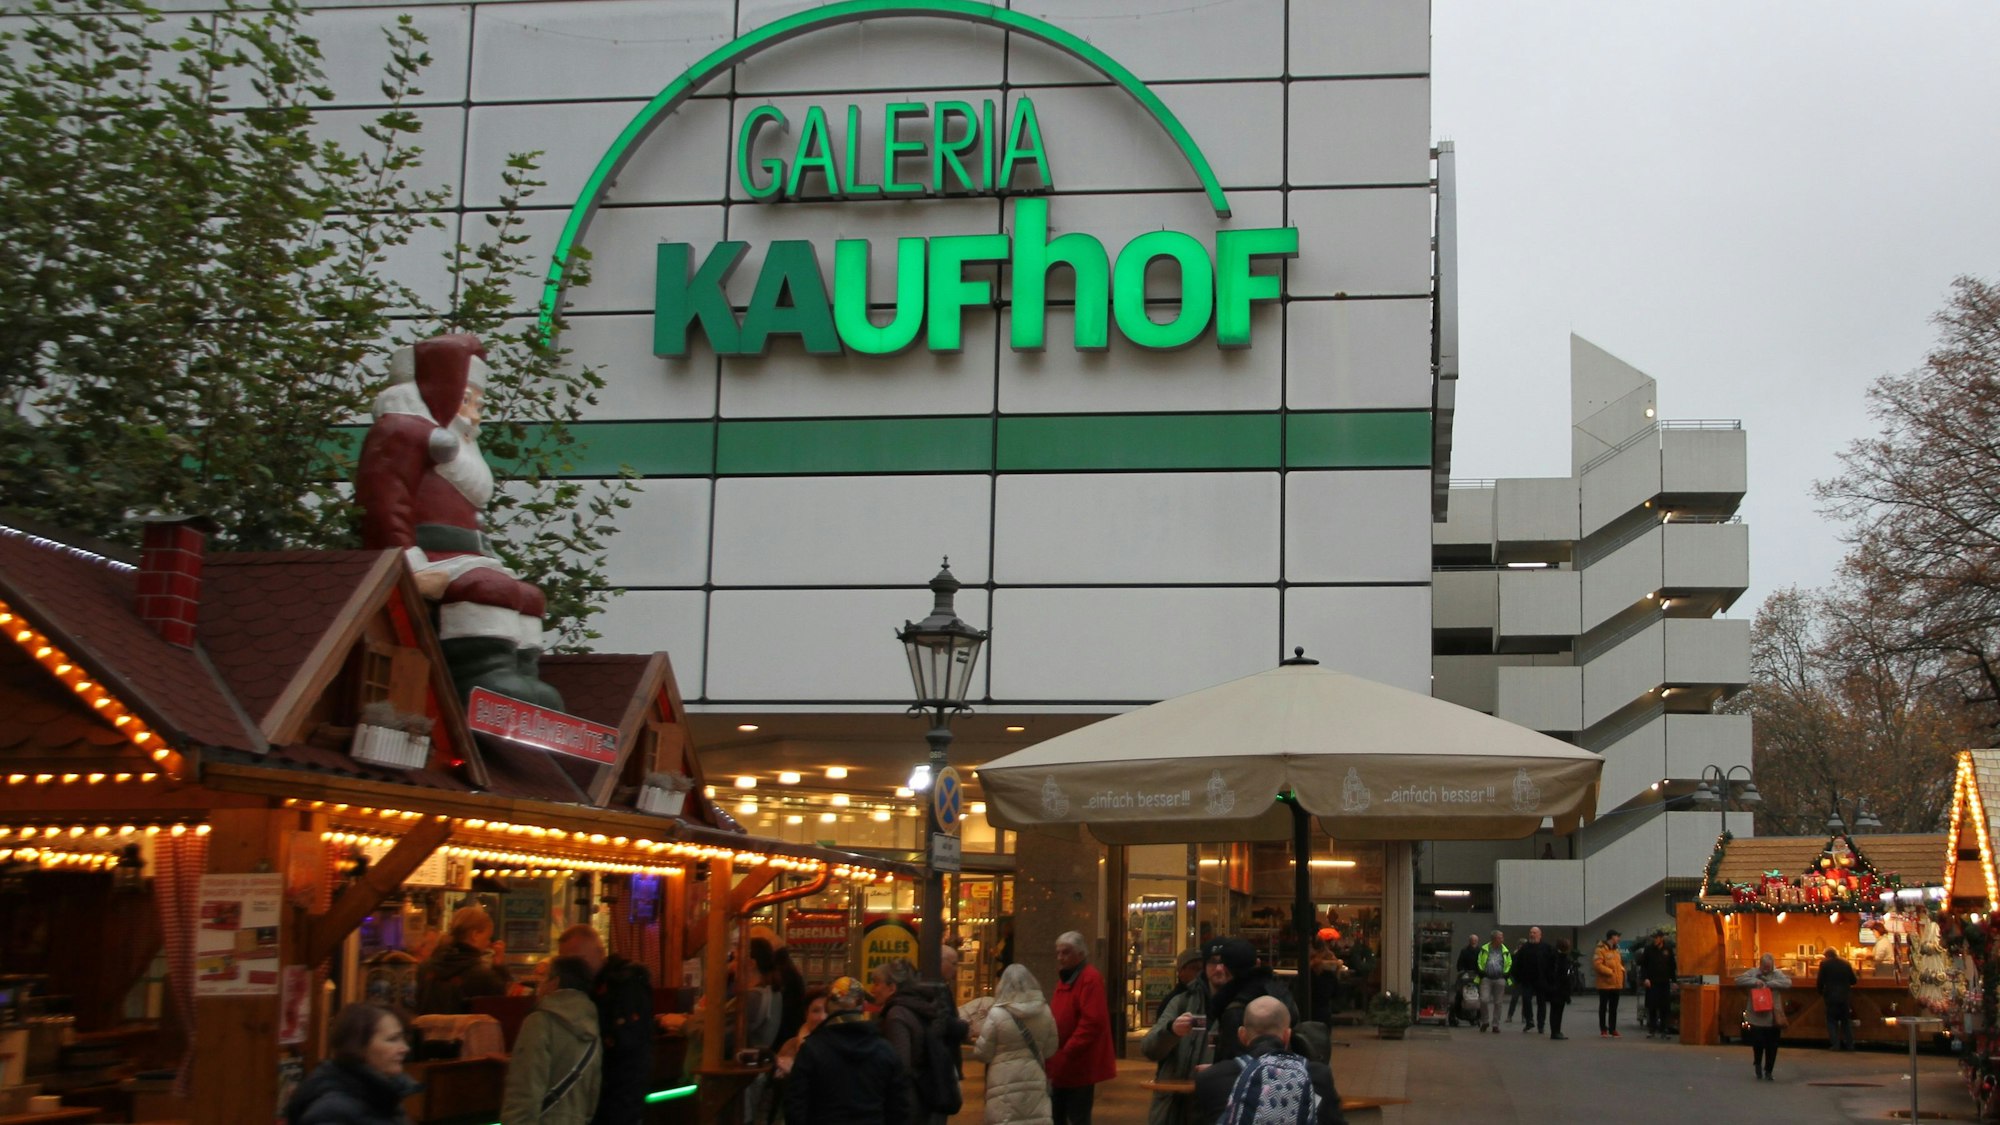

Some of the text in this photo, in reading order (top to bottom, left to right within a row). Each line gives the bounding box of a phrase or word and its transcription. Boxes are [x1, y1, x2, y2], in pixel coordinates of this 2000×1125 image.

[738, 97, 1053, 199] GALERIA
[1138, 789, 1191, 808] besser!!!
[1442, 785, 1495, 803] besser!!!
[789, 926, 847, 940] SPECIALS
[869, 940, 910, 953] ALLES
